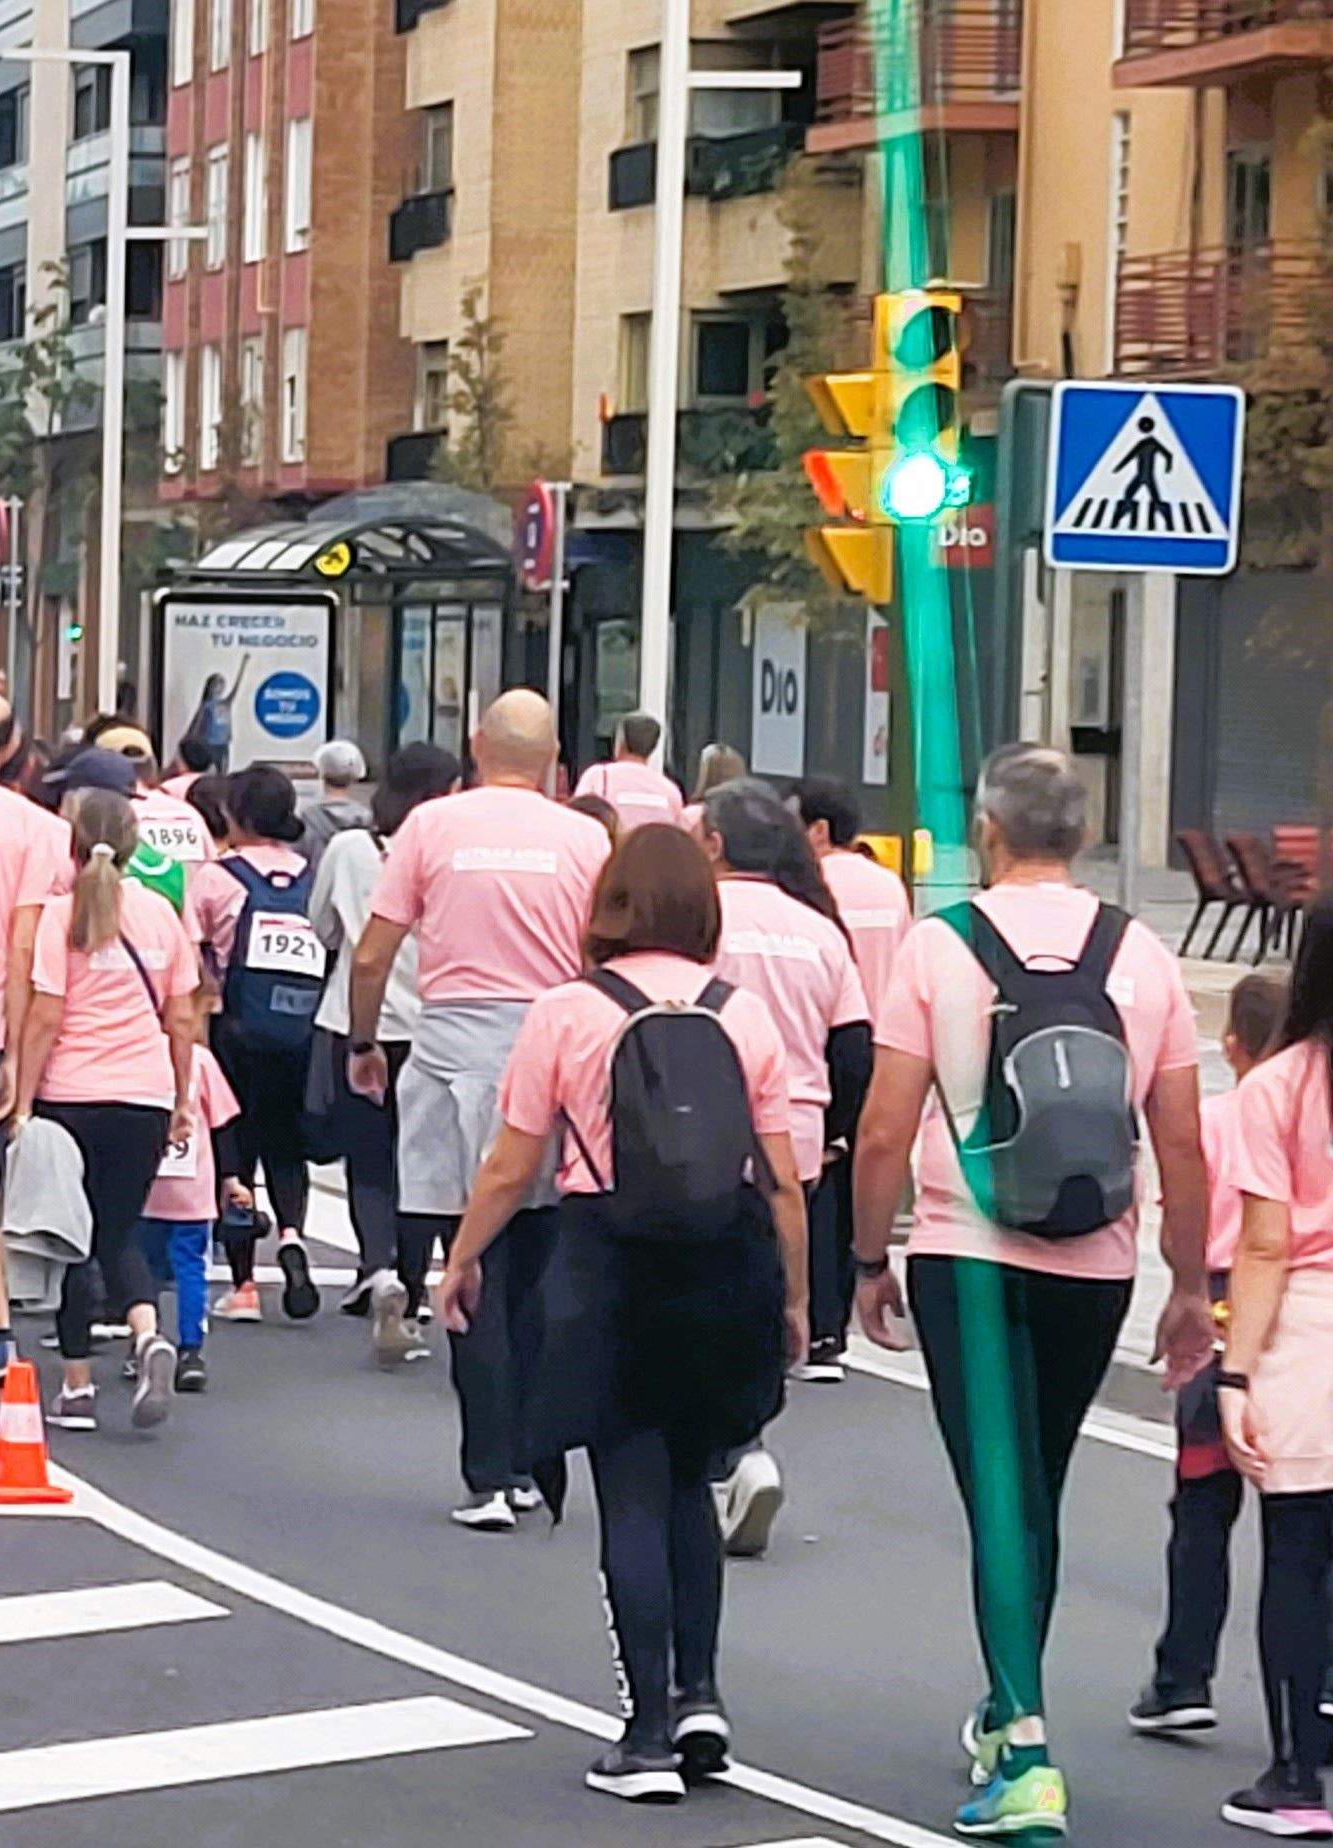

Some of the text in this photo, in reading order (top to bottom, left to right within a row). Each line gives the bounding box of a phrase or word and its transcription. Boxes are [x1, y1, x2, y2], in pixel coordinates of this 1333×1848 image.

[175, 615, 209, 628] HAZ
[212, 634, 318, 648] TU NEGOCIO
[147, 828, 198, 845] 1896
[261, 933, 317, 960] 1921
